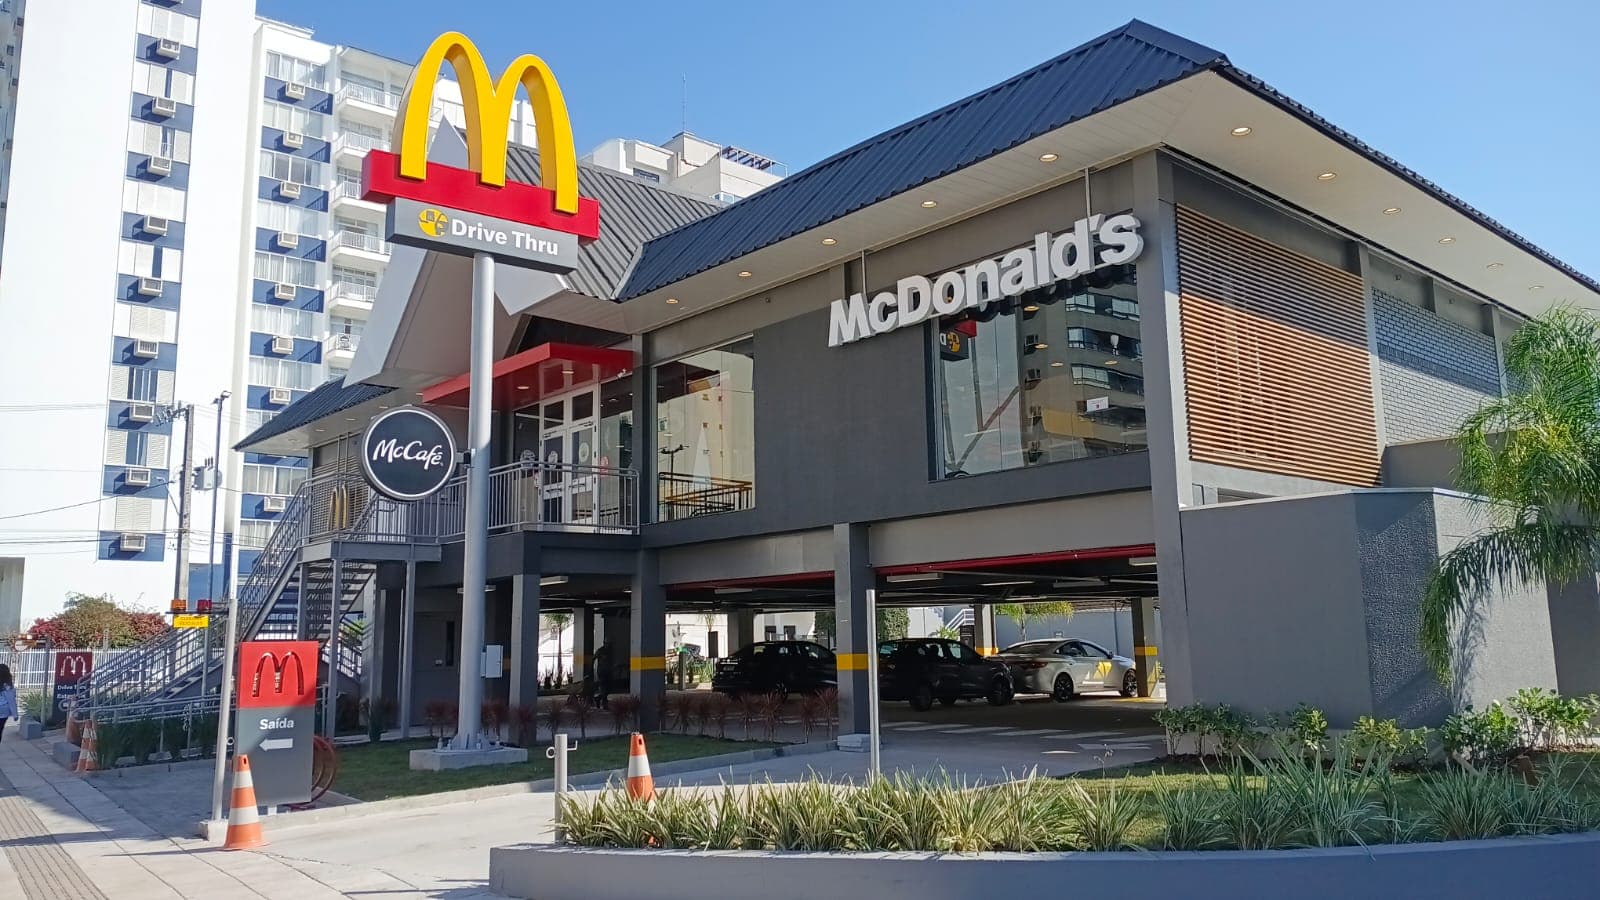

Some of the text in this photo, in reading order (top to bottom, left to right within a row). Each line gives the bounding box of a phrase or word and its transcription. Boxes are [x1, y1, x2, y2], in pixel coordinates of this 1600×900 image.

[451, 218, 559, 256] Drive Thru
[828, 212, 1145, 348] McDonald's
[372, 438, 444, 470] McCafé
[259, 717, 295, 730] Saída
